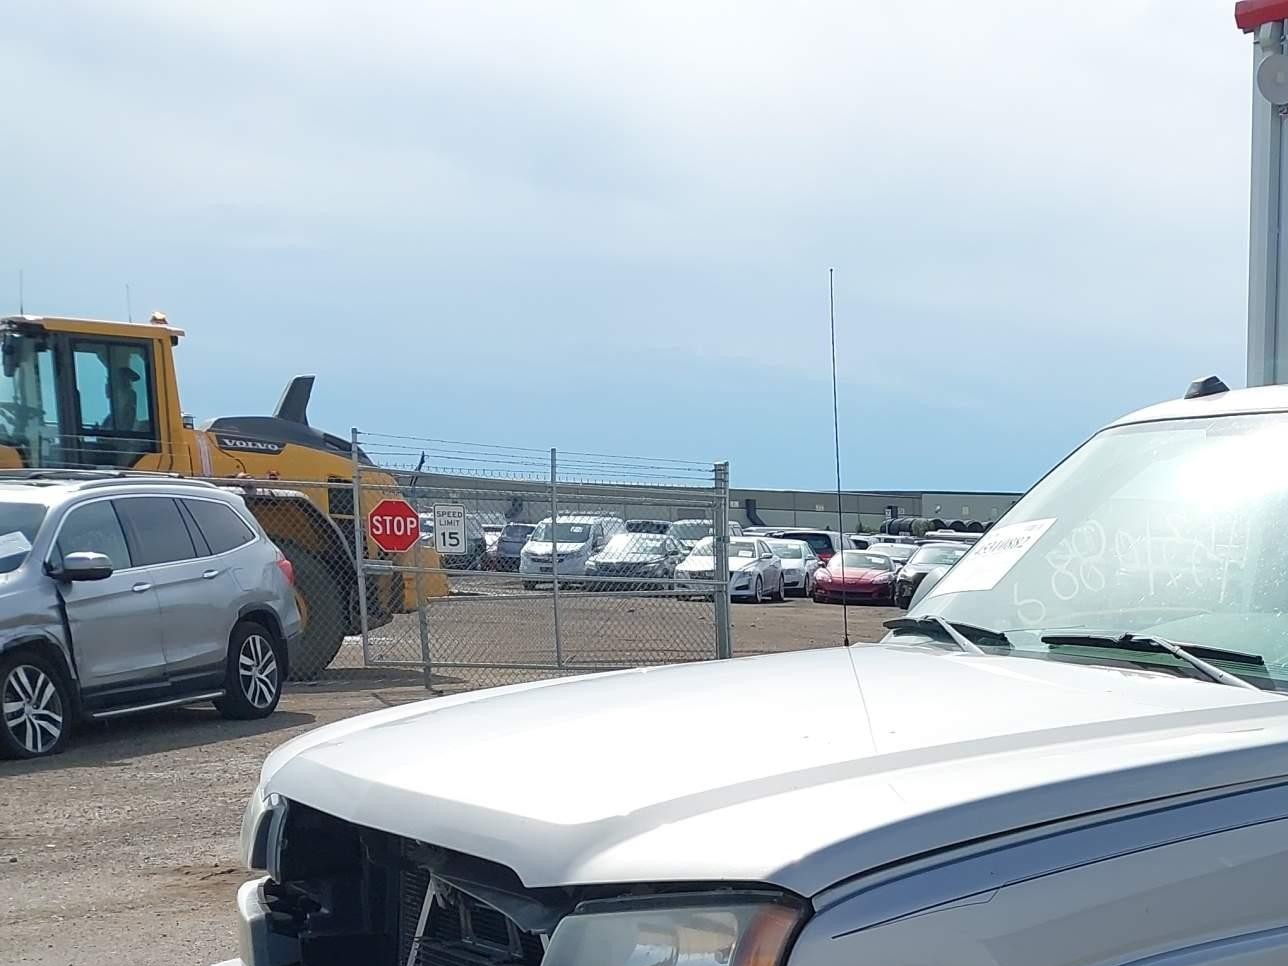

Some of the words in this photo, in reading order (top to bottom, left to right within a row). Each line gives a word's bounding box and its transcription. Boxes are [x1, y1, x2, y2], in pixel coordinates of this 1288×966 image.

[223, 438, 279, 451] VOLVO
[436, 510, 463, 518] SPEED
[372, 515, 417, 536] STOP
[439, 519, 460, 527] LIMIT
[440, 532, 460, 547] 15
